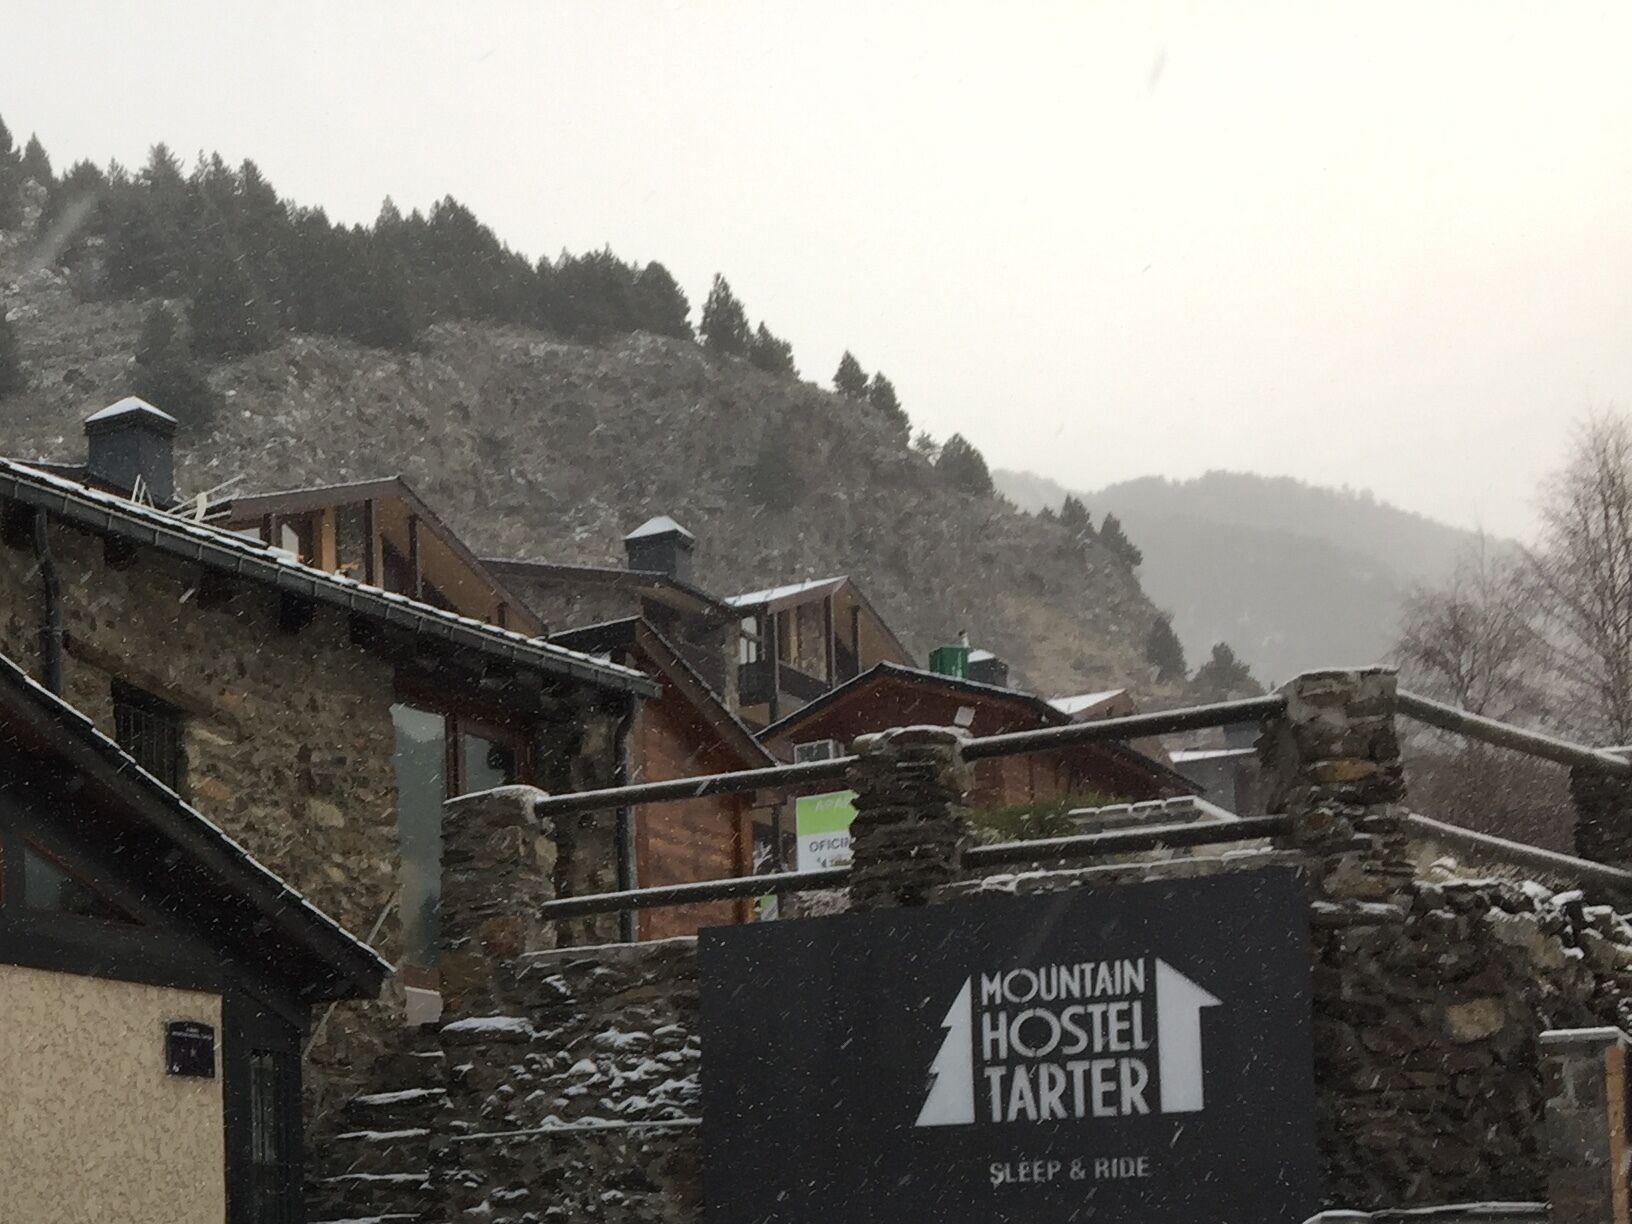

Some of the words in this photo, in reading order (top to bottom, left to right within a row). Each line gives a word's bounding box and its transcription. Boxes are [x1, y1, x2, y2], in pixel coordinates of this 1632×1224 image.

[981, 957, 1146, 1006] MOUNTAIN
[982, 1000, 1150, 1061] HOSTEL
[984, 1057, 1151, 1123] TARTER
[989, 1160, 1062, 1184] SLEEP
[1069, 1158, 1086, 1181] &
[1094, 1156, 1152, 1179] RIDE
